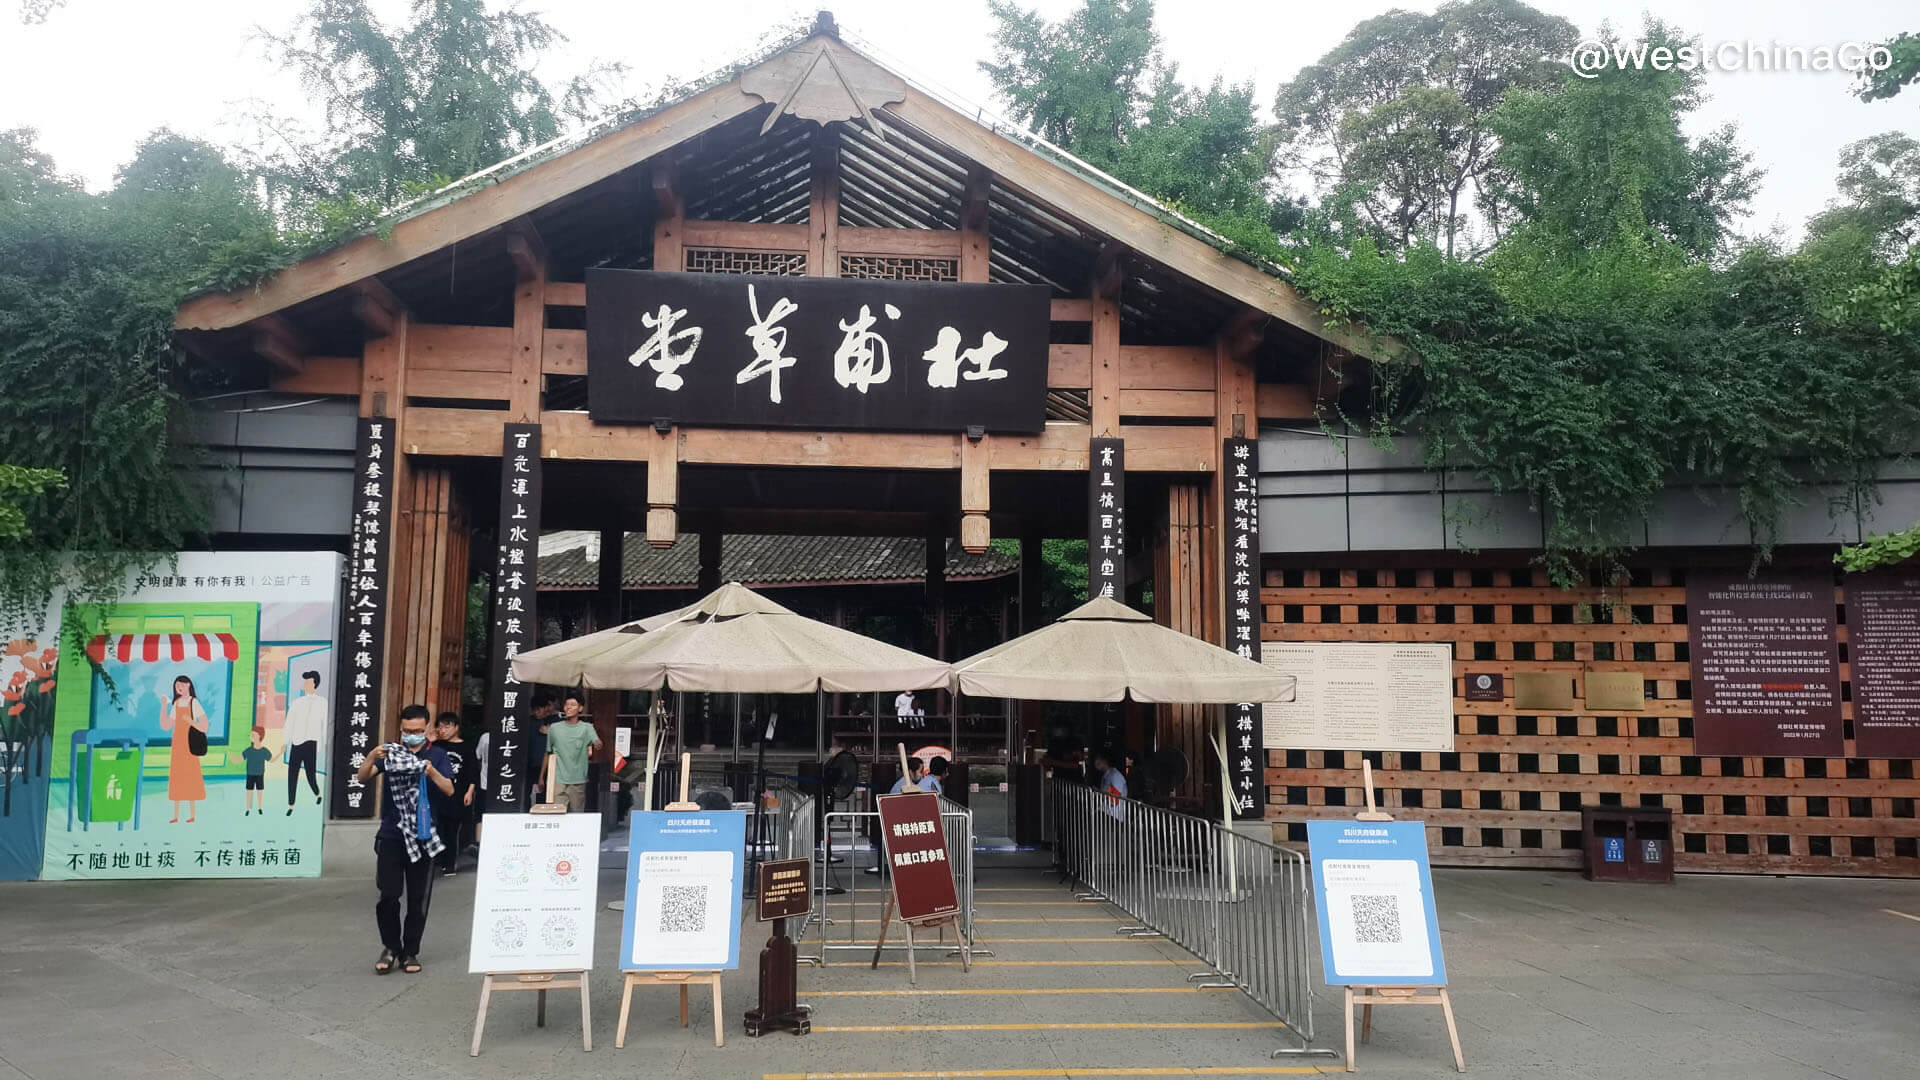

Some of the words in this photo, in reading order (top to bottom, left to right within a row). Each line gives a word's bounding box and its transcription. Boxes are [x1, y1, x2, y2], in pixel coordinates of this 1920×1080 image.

[135, 575, 188, 588] 文明健康
[194, 575, 246, 588] 有你有我
[261, 575, 312, 587] 公益广告
[893, 820, 936, 837] 请保持距离
[66, 851, 176, 871] 不随地吐痰
[194, 848, 301, 867] 不传播病菌
[894, 848, 946, 867] 佩戴口罩参观
